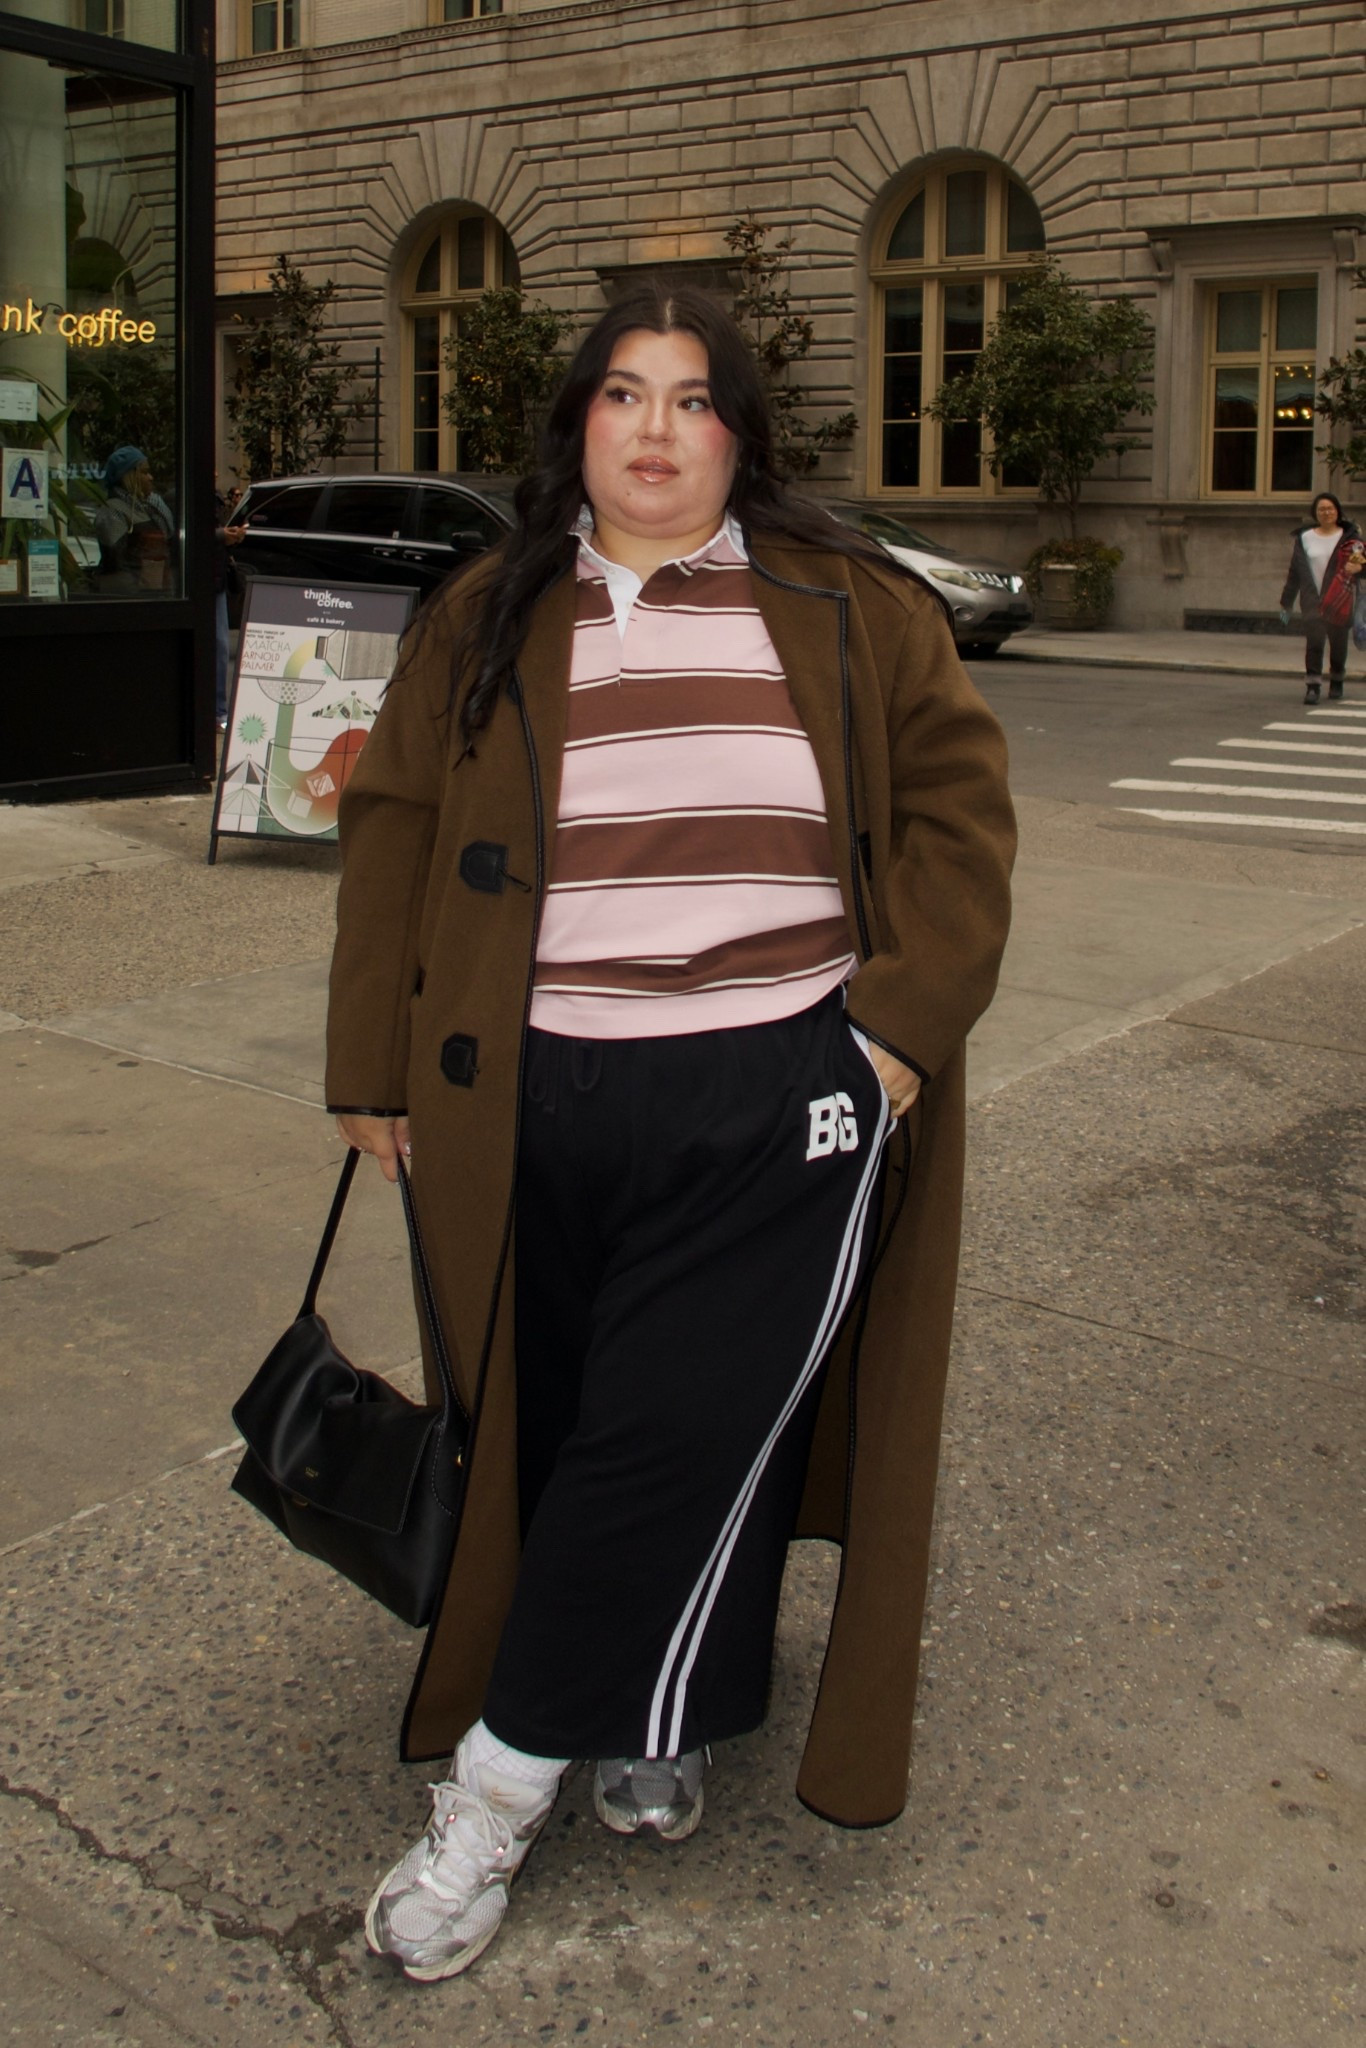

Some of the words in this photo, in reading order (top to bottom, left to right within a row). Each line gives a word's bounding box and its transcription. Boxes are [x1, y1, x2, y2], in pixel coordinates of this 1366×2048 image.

[2, 298, 43, 334] nk
[58, 308, 156, 344] coffee
[9, 457, 41, 499] A
[304, 589, 333, 600] think
[325, 617, 345, 626] bakery
[245, 639, 291, 653] MATCHA
[242, 651, 280, 662] ARNOLD
[806, 1091, 859, 1161] BG
